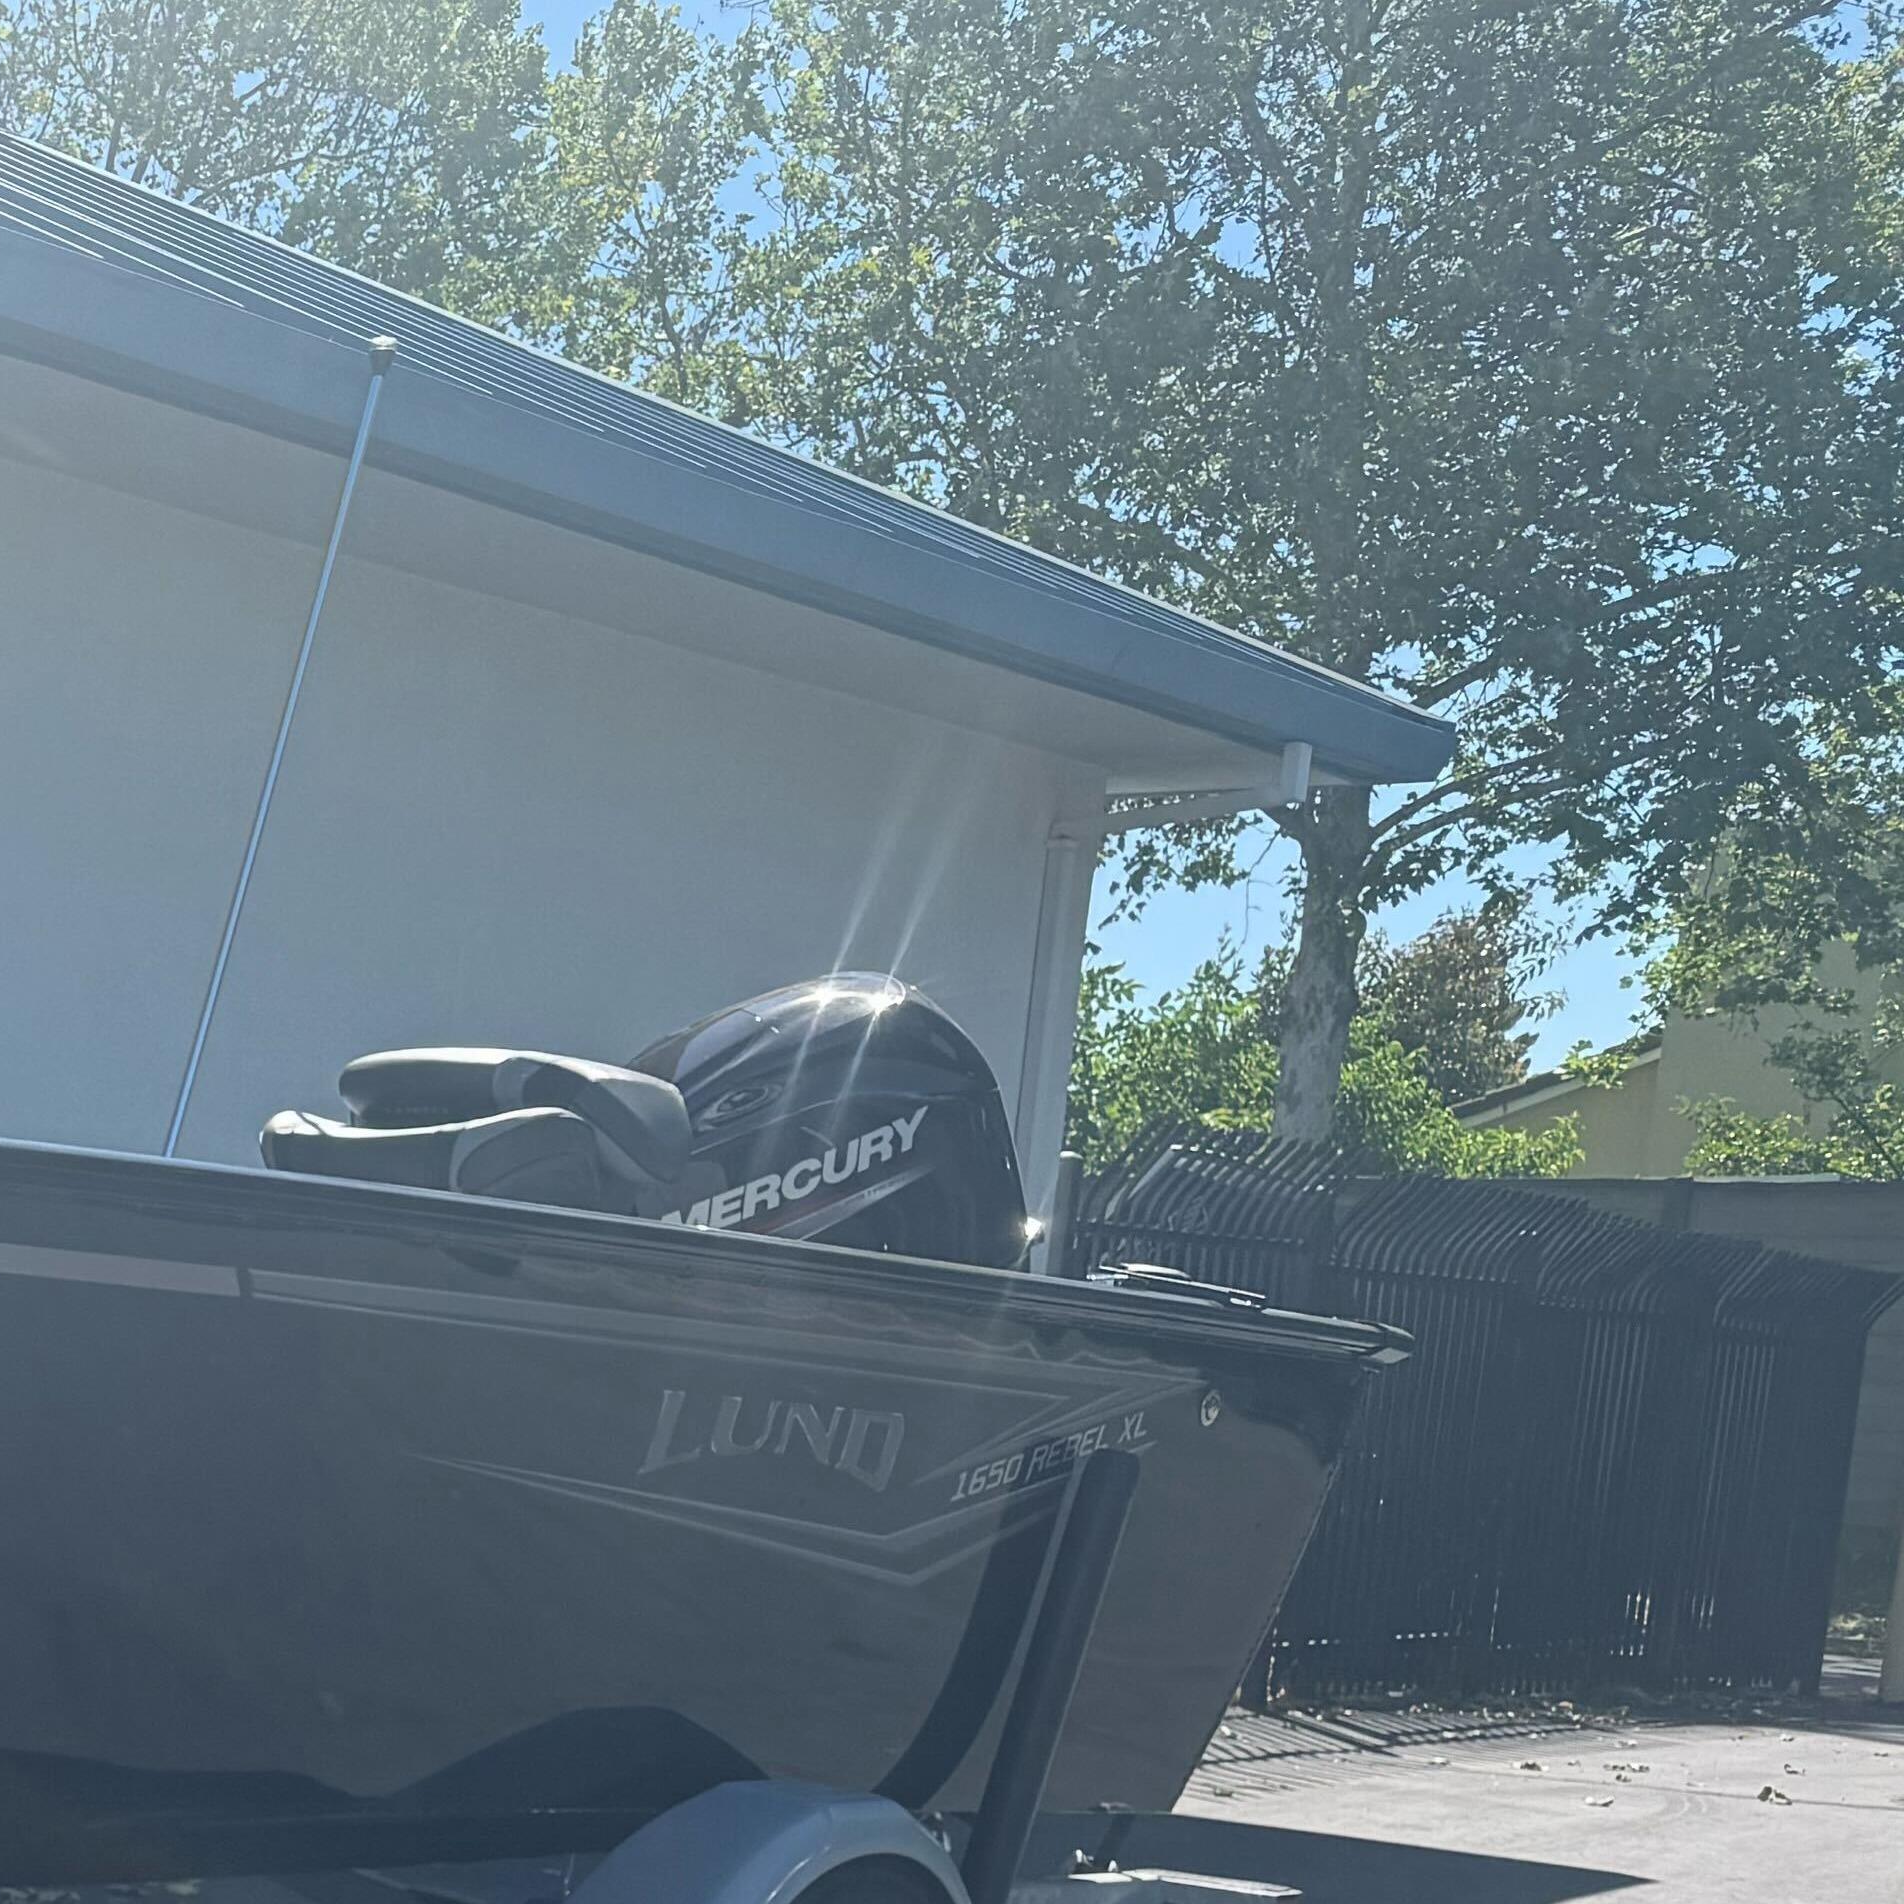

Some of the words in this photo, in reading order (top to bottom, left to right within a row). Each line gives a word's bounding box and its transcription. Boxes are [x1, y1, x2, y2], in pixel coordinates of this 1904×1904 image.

[660, 1105, 929, 1229] MERCURY
[636, 1390, 905, 1493] LUND
[950, 1461, 1024, 1501] 1650
[1026, 1424, 1110, 1484] REBEL
[1118, 1411, 1147, 1441] XL
